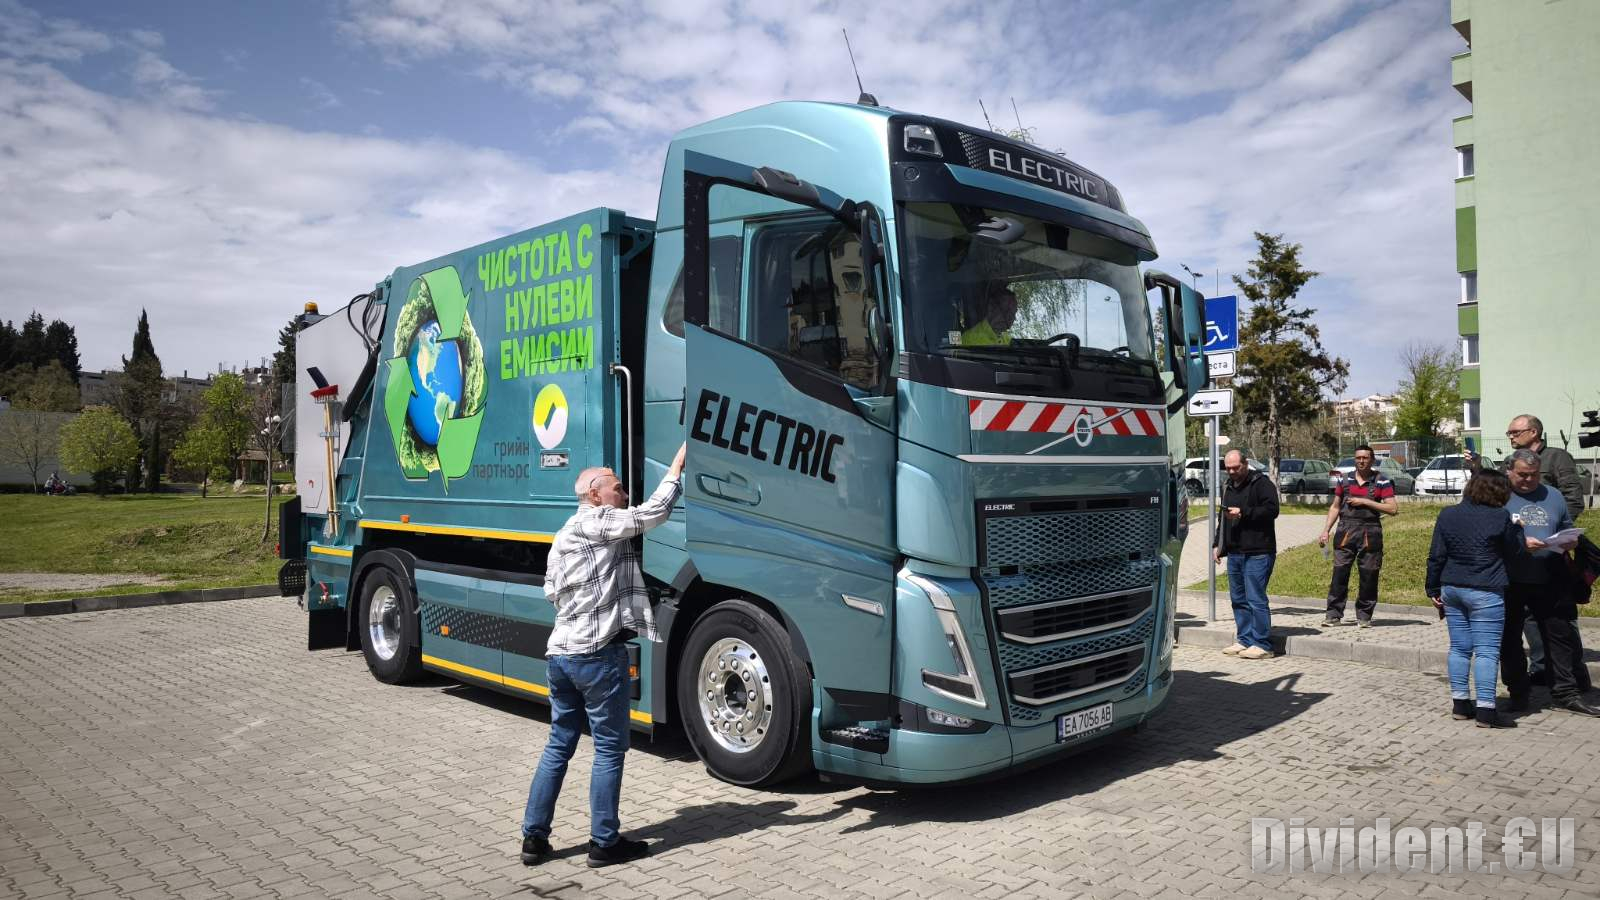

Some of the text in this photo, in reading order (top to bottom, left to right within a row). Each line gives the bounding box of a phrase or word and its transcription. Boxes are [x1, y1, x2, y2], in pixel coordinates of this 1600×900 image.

[989, 148, 1098, 198] ELECTRIC
[478, 223, 593, 292] ЧИСТОТА С
[505, 274, 593, 333] НУЛЕВИ
[501, 325, 594, 380] ЕМИСИИ
[494, 436, 530, 461] грийн
[691, 388, 844, 483] ELECTRIC
[472, 463, 530, 483] партнърс
[985, 503, 1016, 511] ELECTRIC
[1079, 709, 1100, 731] 7056
